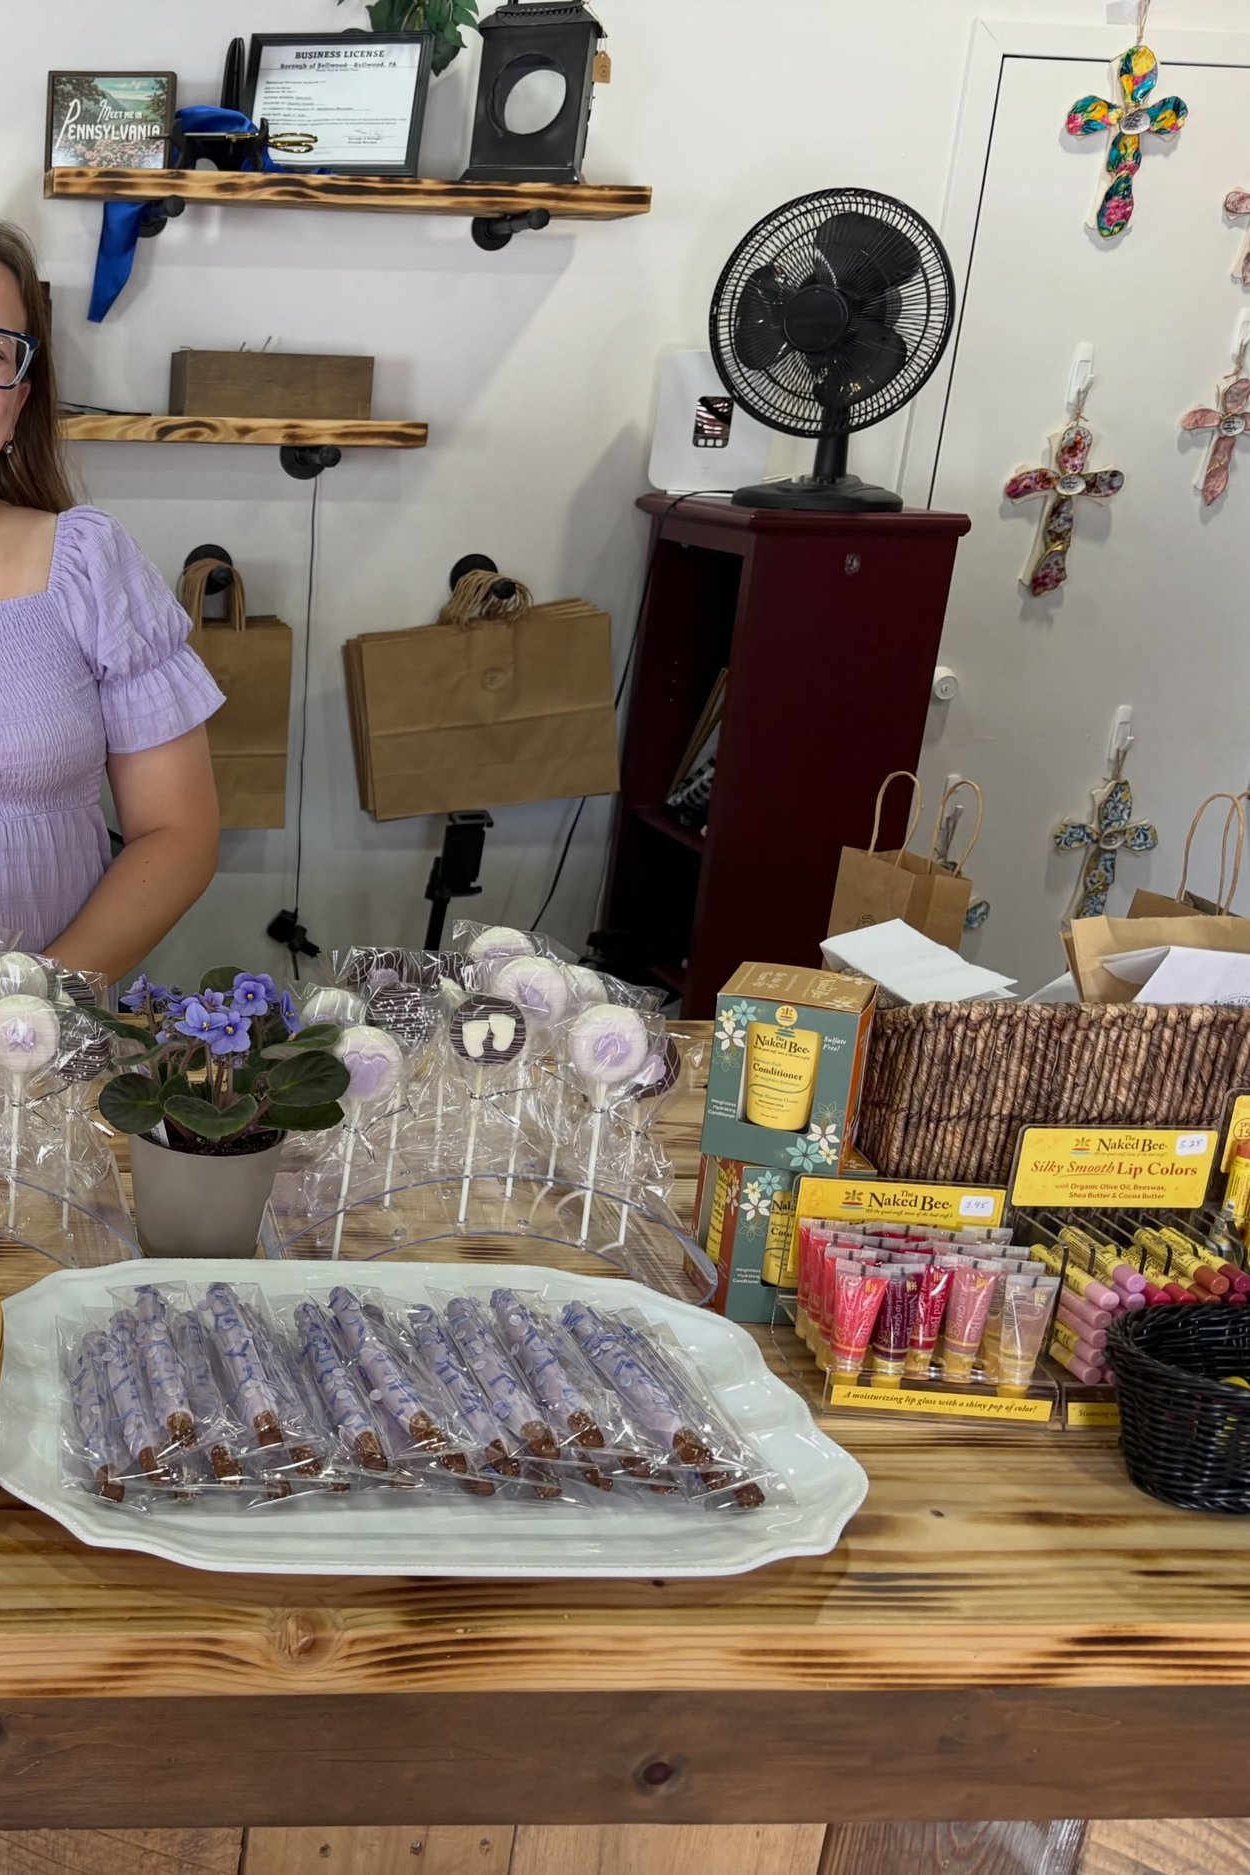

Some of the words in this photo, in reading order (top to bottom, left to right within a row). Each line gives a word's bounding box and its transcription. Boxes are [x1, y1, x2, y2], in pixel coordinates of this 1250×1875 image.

[295, 51, 341, 59] BUSINESS
[344, 50, 385, 58] LICENSE
[124, 110, 134, 119] ME
[55, 99, 161, 150] PENNSYLVANIA
[755, 1034, 788, 1050] Naked
[788, 1041, 808, 1054] Bee
[822, 1043, 840, 1052] Free!
[823, 1036, 846, 1046] Sulfate
[752, 1062, 803, 1081] Conditioner
[1238, 1128, 1250, 1138] 15
[1097, 1138, 1139, 1152] Naked
[1141, 1139, 1165, 1152] Bee
[1031, 1160, 1064, 1174] Silky
[1066, 1161, 1115, 1174] Smooth
[1117, 1162, 1143, 1179] Lip
[1148, 1162, 1198, 1176] Colors
[1070, 1183, 1099, 1191] Organic
[867, 1192, 918, 1208] Naked
[919, 1195, 949, 1211] Bee
[852, 1393, 904, 1404] moisturizing
[905, 1396, 916, 1405] lip
[916, 1397, 936, 1406] gloss
[965, 1401, 987, 1411] shiny
[987, 1403, 1003, 1412] pop
[1005, 1402, 1015, 1413] of
[1015, 1404, 1038, 1413] color!
